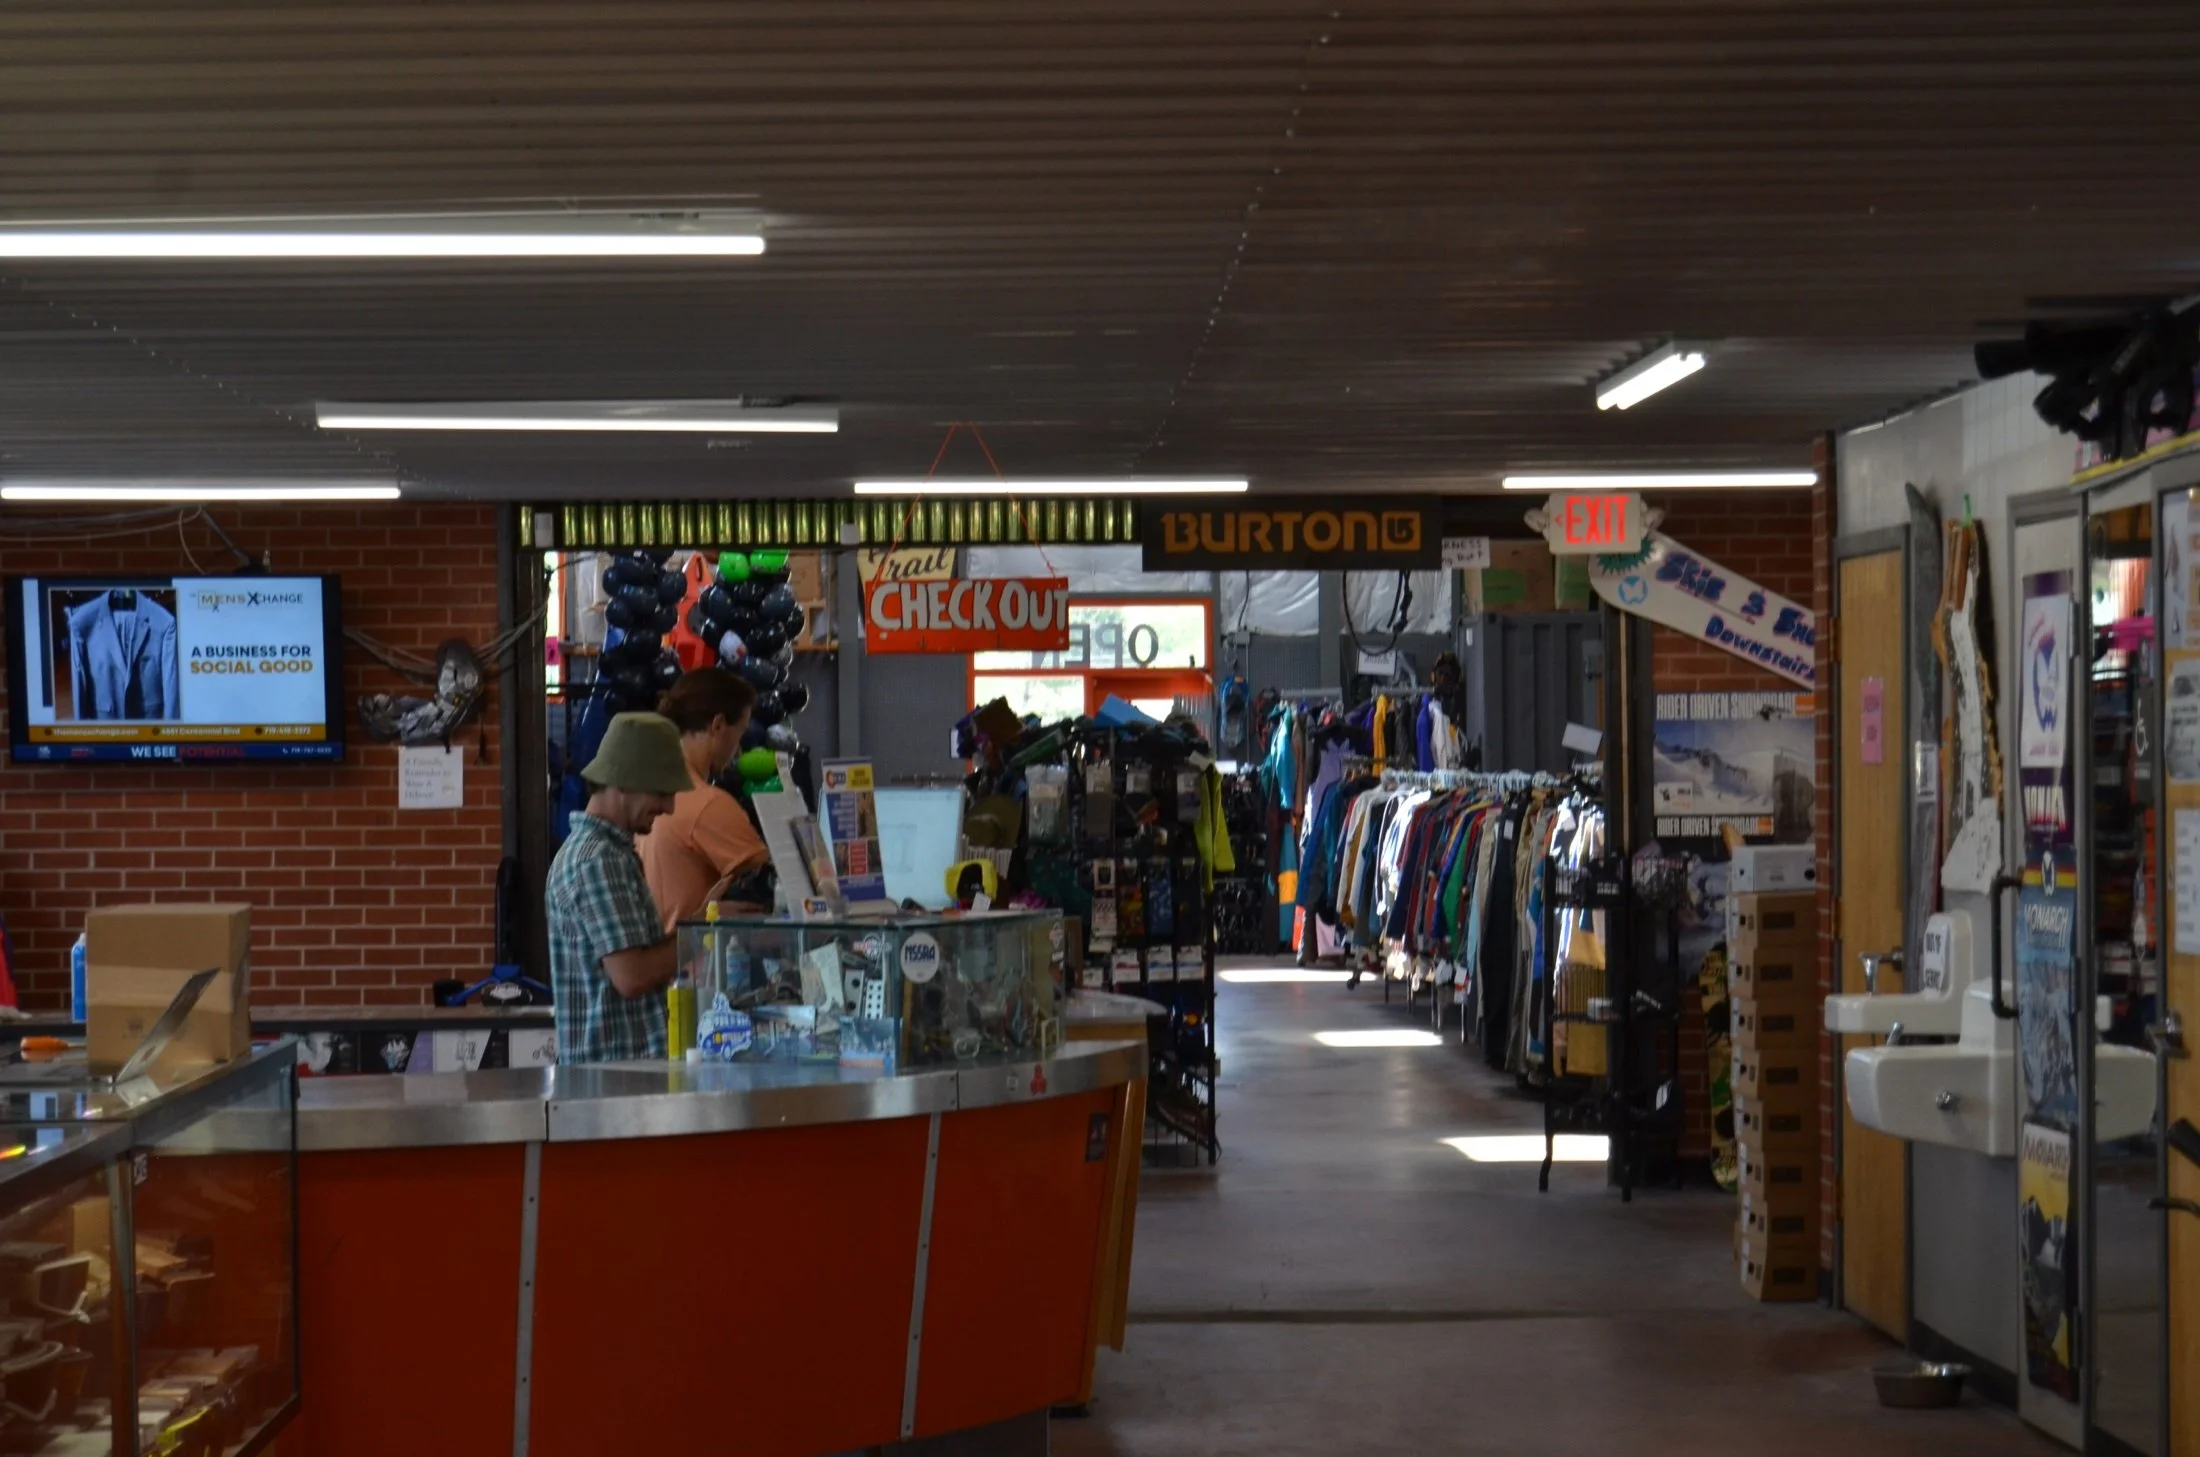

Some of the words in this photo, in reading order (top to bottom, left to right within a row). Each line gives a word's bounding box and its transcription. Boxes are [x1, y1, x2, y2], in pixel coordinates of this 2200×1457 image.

[1565, 495, 1629, 546] EXIT
[1162, 511, 1378, 553] BURTON
[191, 646, 201, 657] A
[205, 645, 278, 657] BUSINESS
[281, 645, 312, 657] FOR
[190, 660, 256, 674] SOCIAL
[259, 659, 314, 673] GOOD
[1656, 693, 1688, 720] RIDER
[1689, 692, 1729, 720] DRIVEN
[131, 745, 152, 758] WE
[154, 745, 177, 758] SEE
[1656, 815, 1680, 836] RIDER
[1681, 815, 1710, 836] DRIVEN
